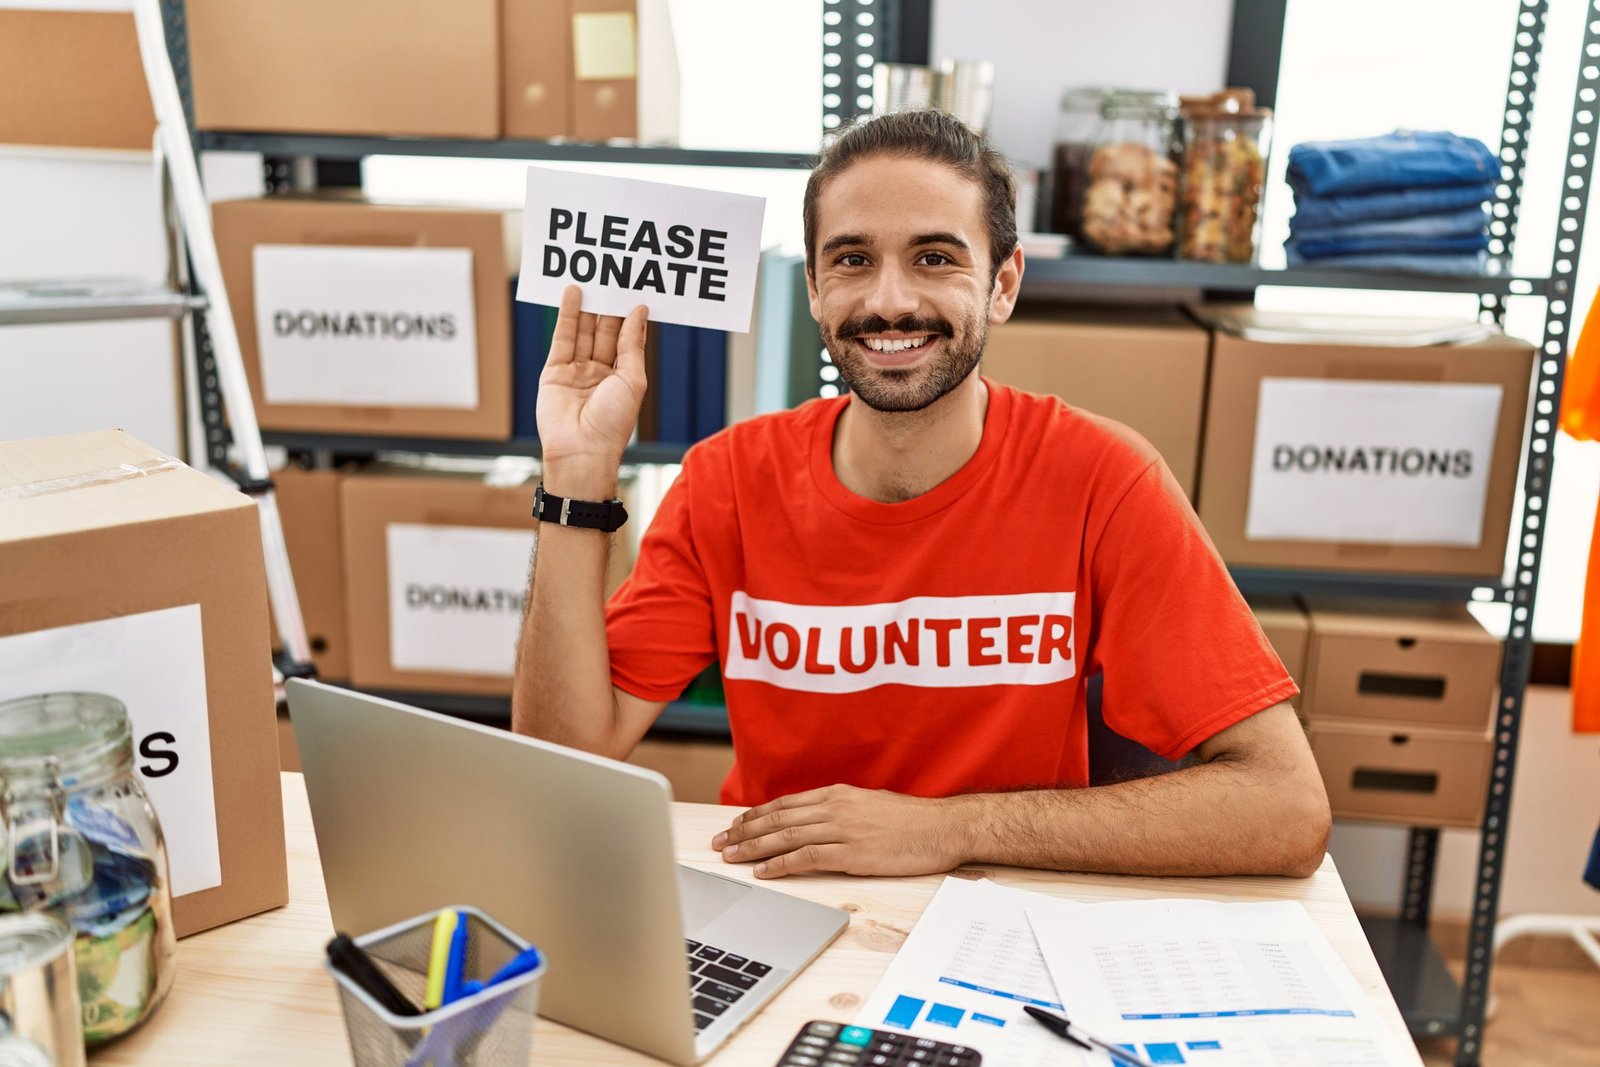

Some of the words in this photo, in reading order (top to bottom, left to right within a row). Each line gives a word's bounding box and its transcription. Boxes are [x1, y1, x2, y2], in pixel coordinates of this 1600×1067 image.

[549, 208, 728, 264] PLEASE
[542, 244, 729, 302] DONATE
[273, 309, 457, 341] DONATIONS
[1272, 443, 1474, 479] DONATIONS
[405, 583, 523, 613] DONATI
[735, 614, 1073, 675] VOLUNTEER
